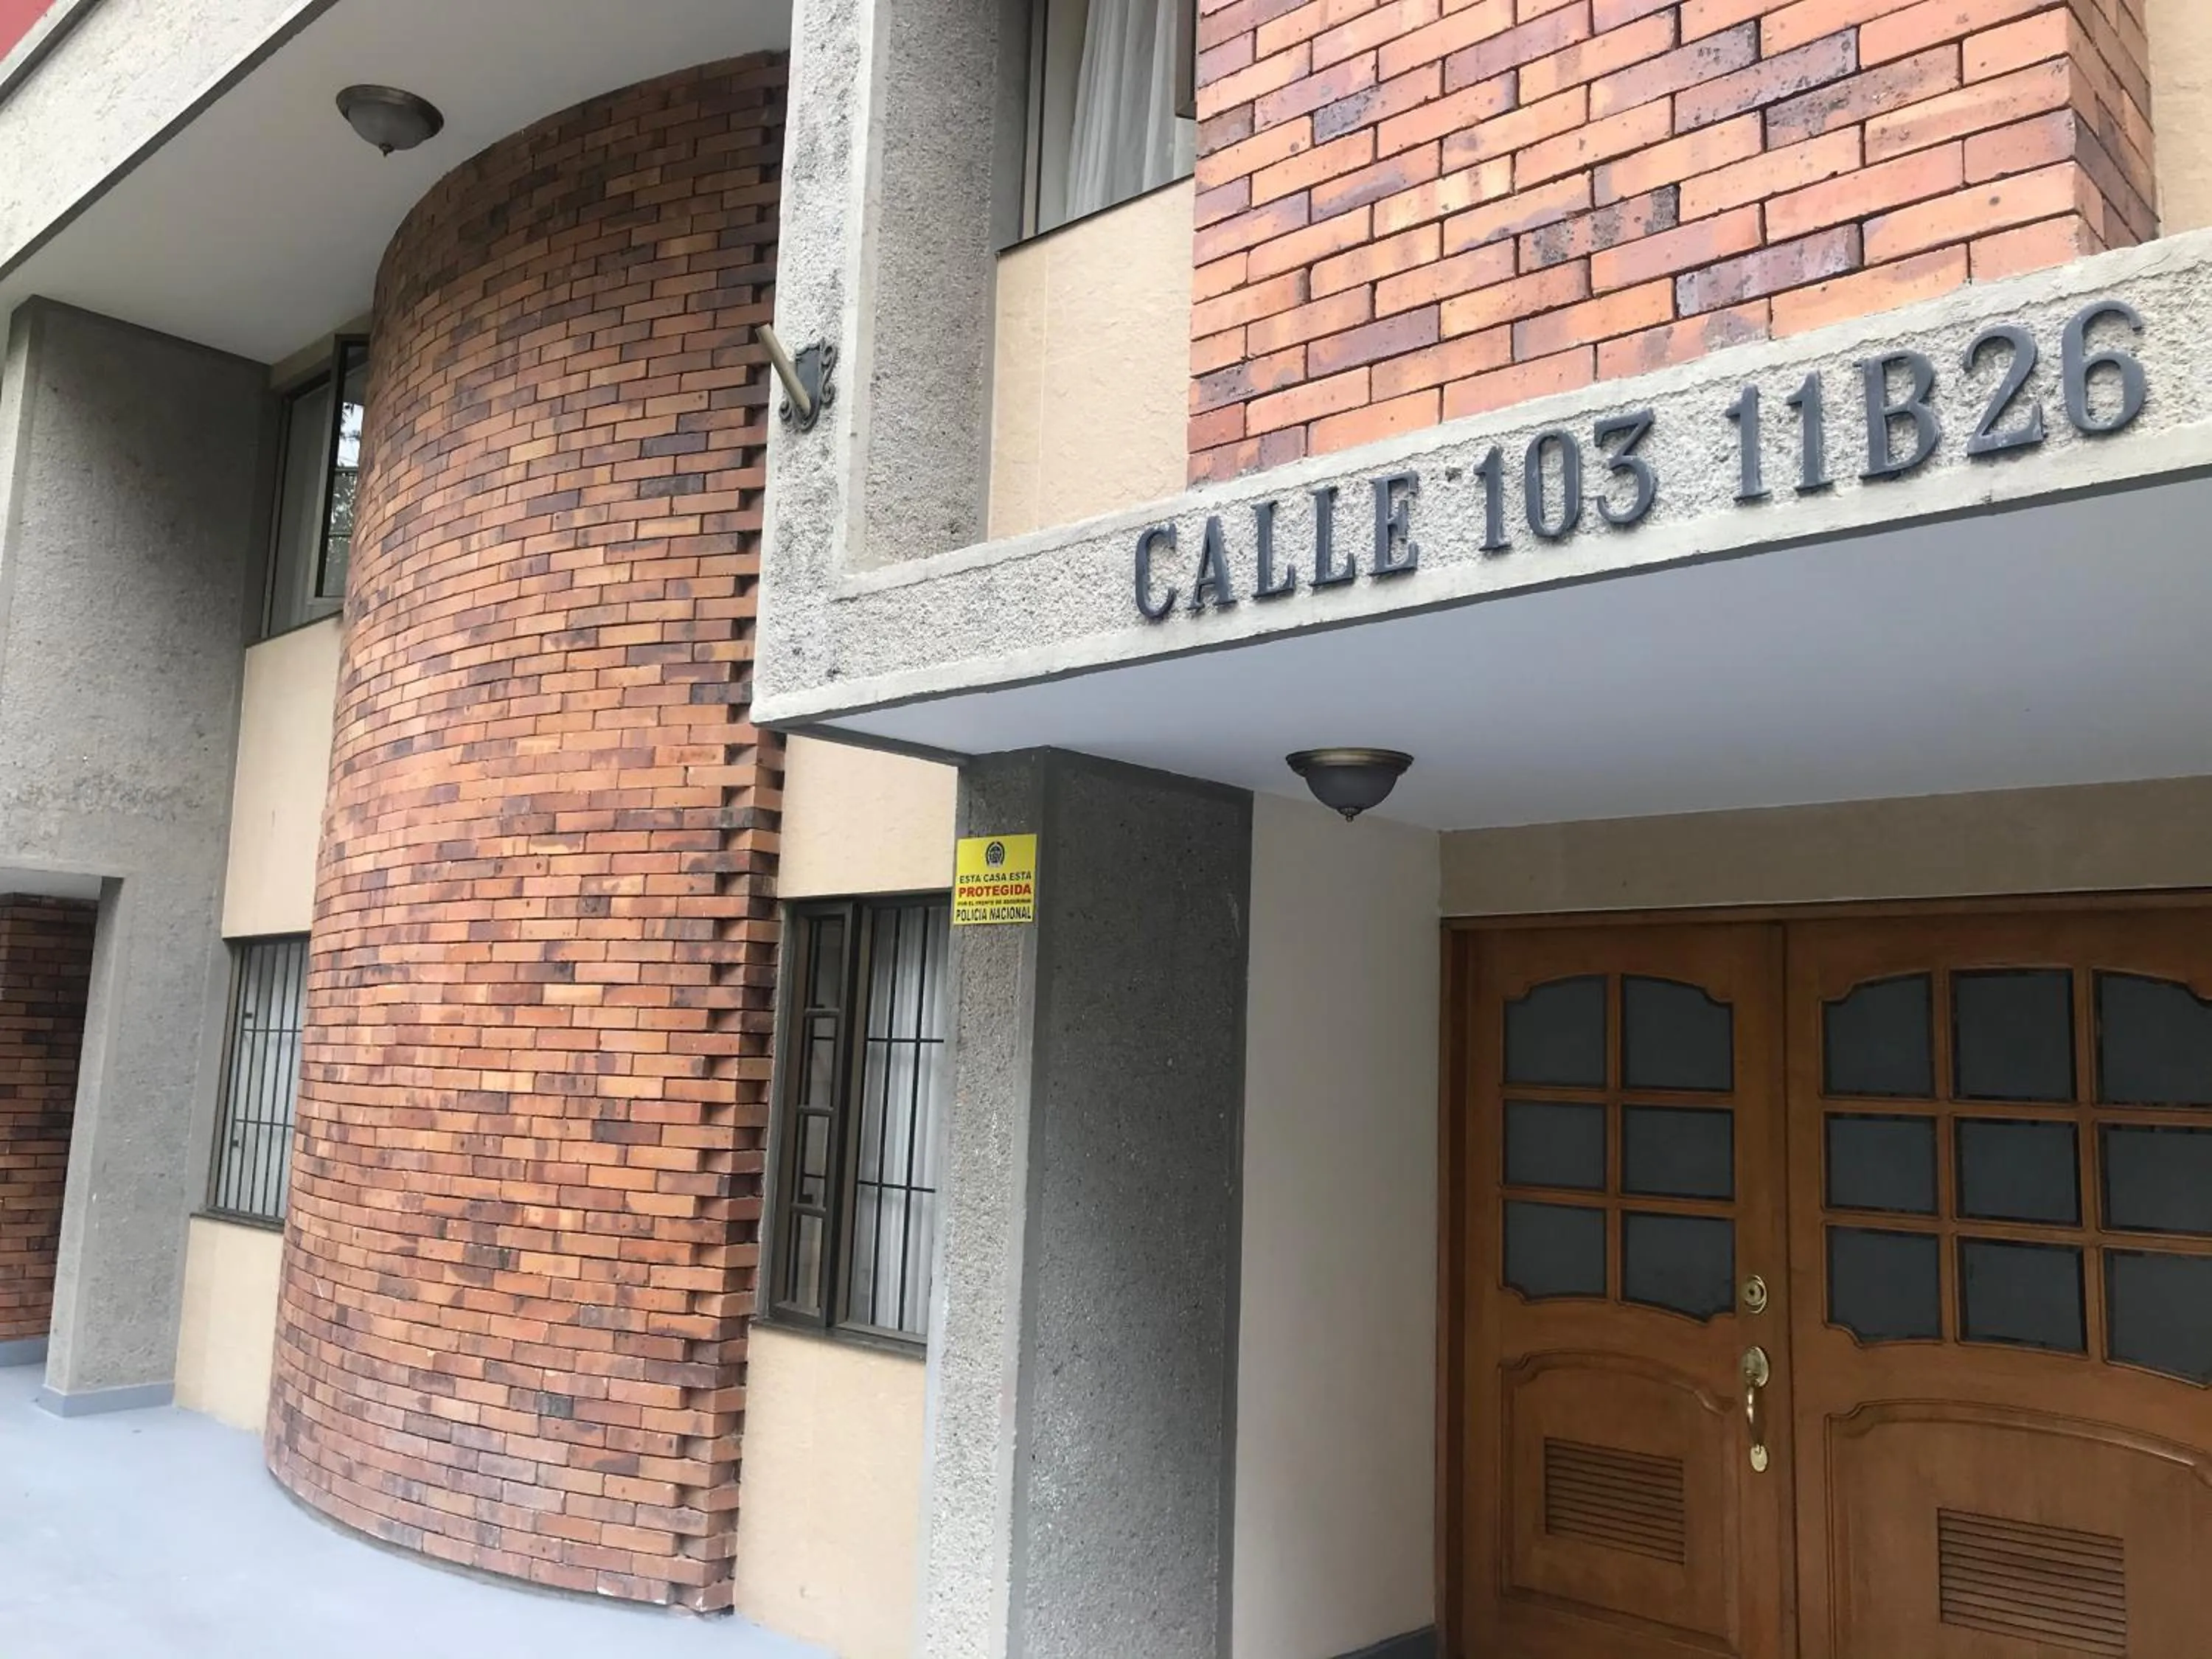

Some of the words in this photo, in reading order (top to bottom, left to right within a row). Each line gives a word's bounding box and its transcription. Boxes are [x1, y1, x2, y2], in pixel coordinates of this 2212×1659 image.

[1134, 470, 1420, 619] CALLE
[1474, 408, 1658, 553] 103
[959, 874, 981, 883] ESTA
[984, 873, 1006, 883] CASA
[959, 884, 1032, 897] PROTEGIDA
[990, 906, 1032, 920] NACIONAL
